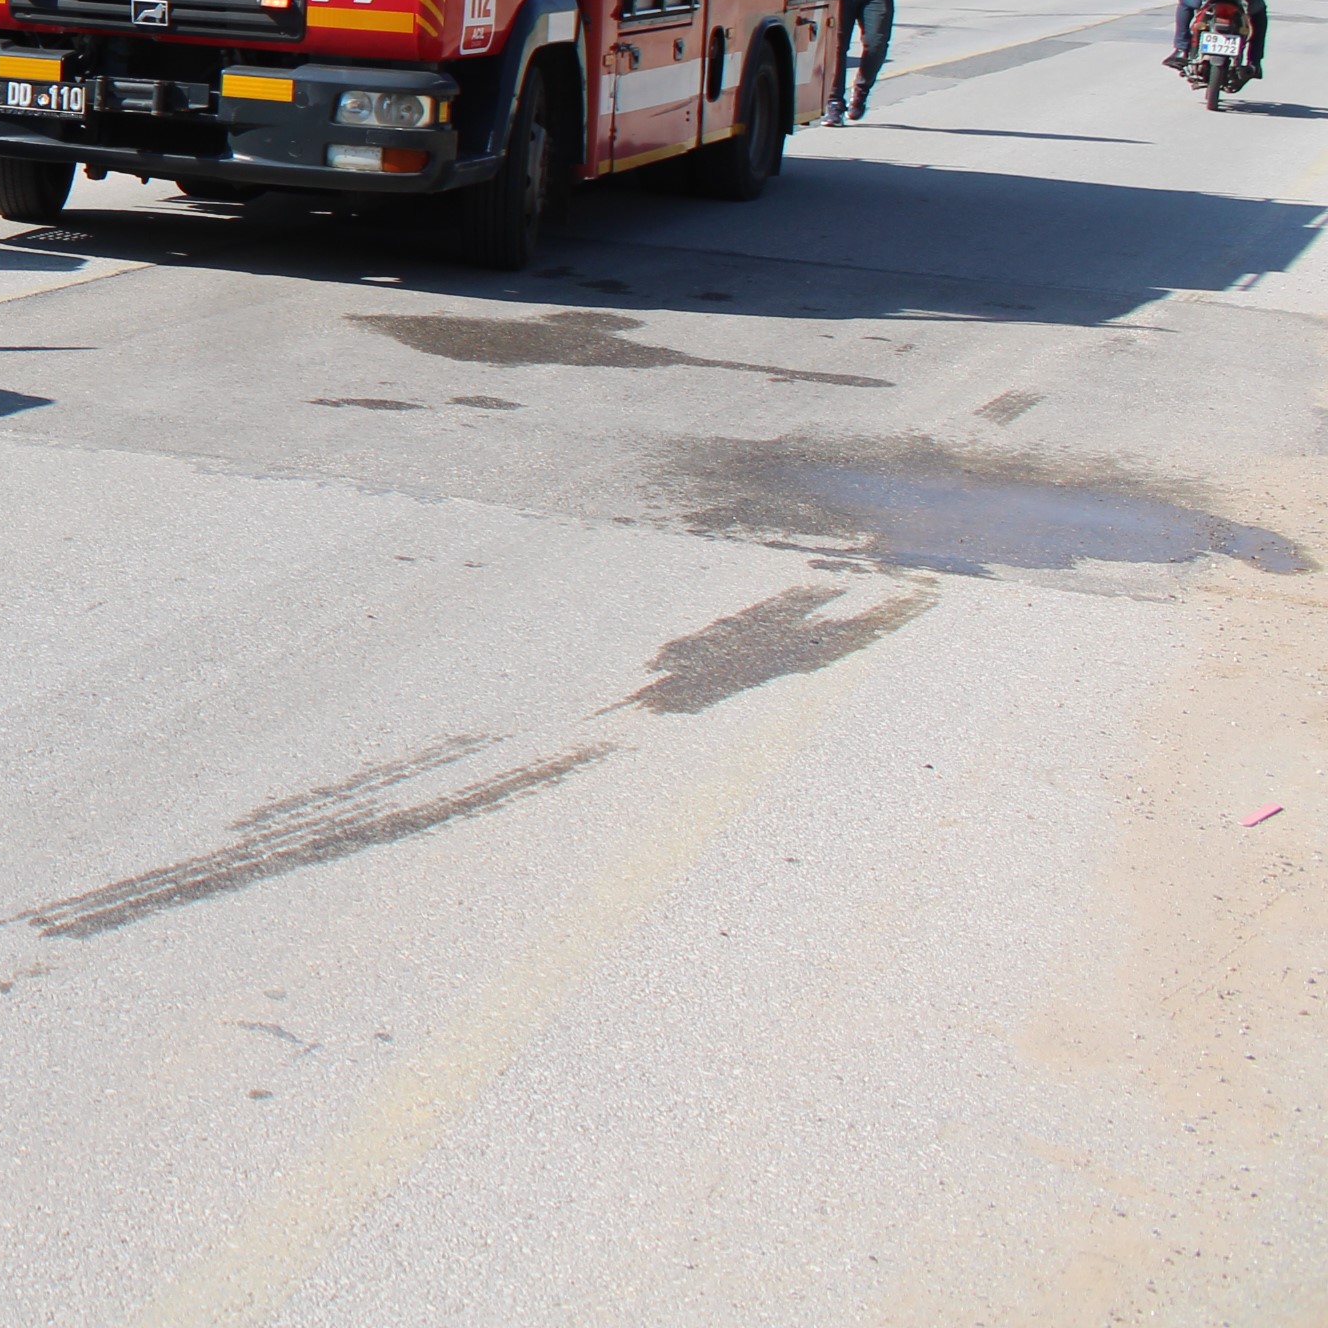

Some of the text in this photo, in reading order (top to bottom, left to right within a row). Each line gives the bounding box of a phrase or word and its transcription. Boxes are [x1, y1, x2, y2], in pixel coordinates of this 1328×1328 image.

[1206, 35, 1218, 43] 09
[1212, 44, 1237, 53] 1772
[7, 81, 32, 107] DD
[48, 85, 83, 111] 110
